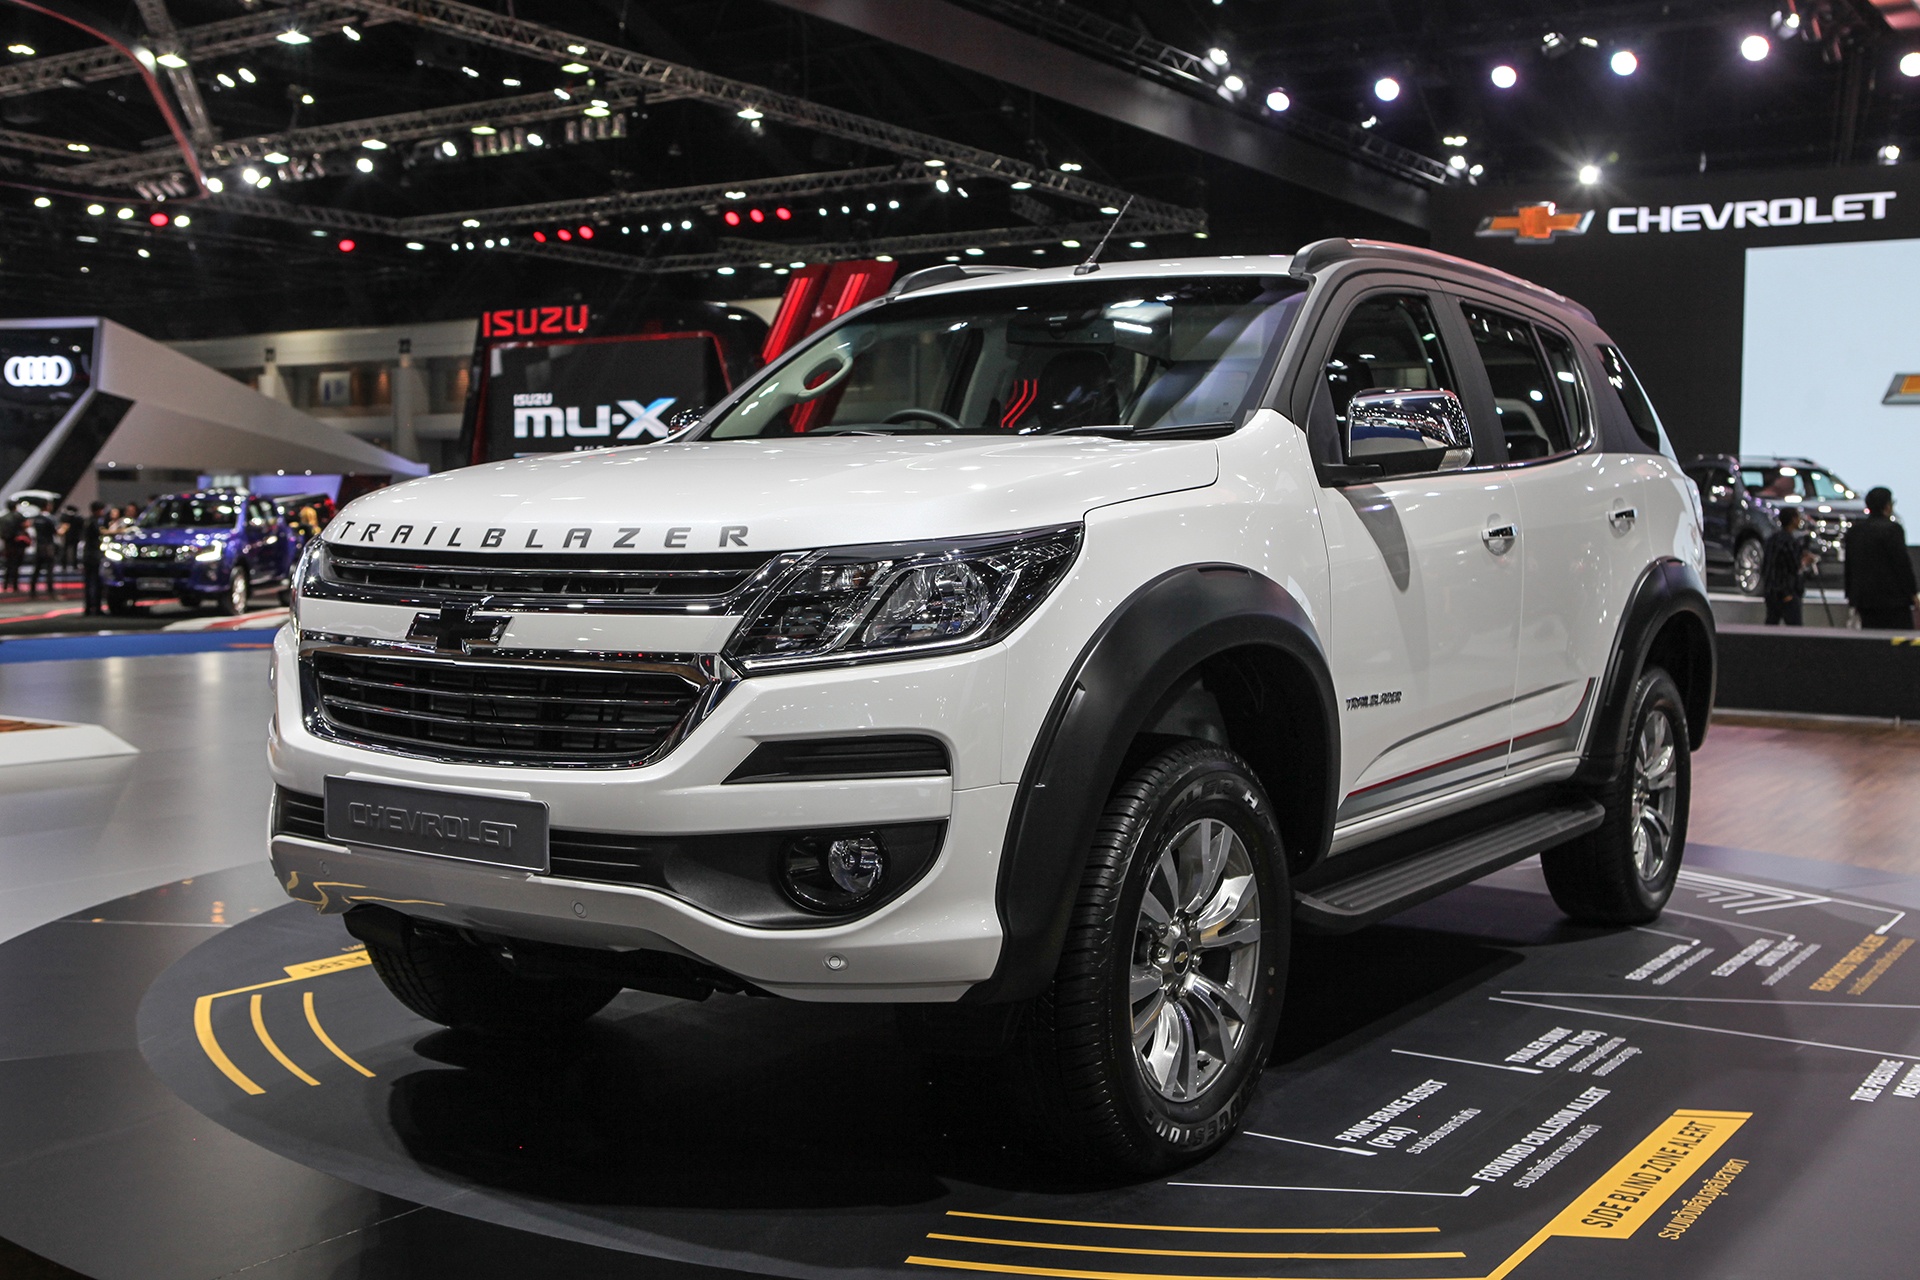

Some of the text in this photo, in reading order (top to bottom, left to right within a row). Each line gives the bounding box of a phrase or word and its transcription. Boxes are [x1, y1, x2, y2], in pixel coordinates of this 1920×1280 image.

[1608, 190, 1897, 235] CHEVROLET
[483, 304, 589, 338] ISUZU
[513, 393, 553, 406] ISUZU
[339, 521, 751, 549] TRAILBLAZER
[348, 801, 518, 850] CHEVROLET
[1334, 1079, 1447, 1143] PANIC BRAKE ASSIST
[1366, 1126, 1418, 1149] (PBA)
[1471, 1086, 1611, 1182] FORWARD COLLISION ALERT
[1581, 1121, 1716, 1229] SIDE BLIND ZONE ALERT
